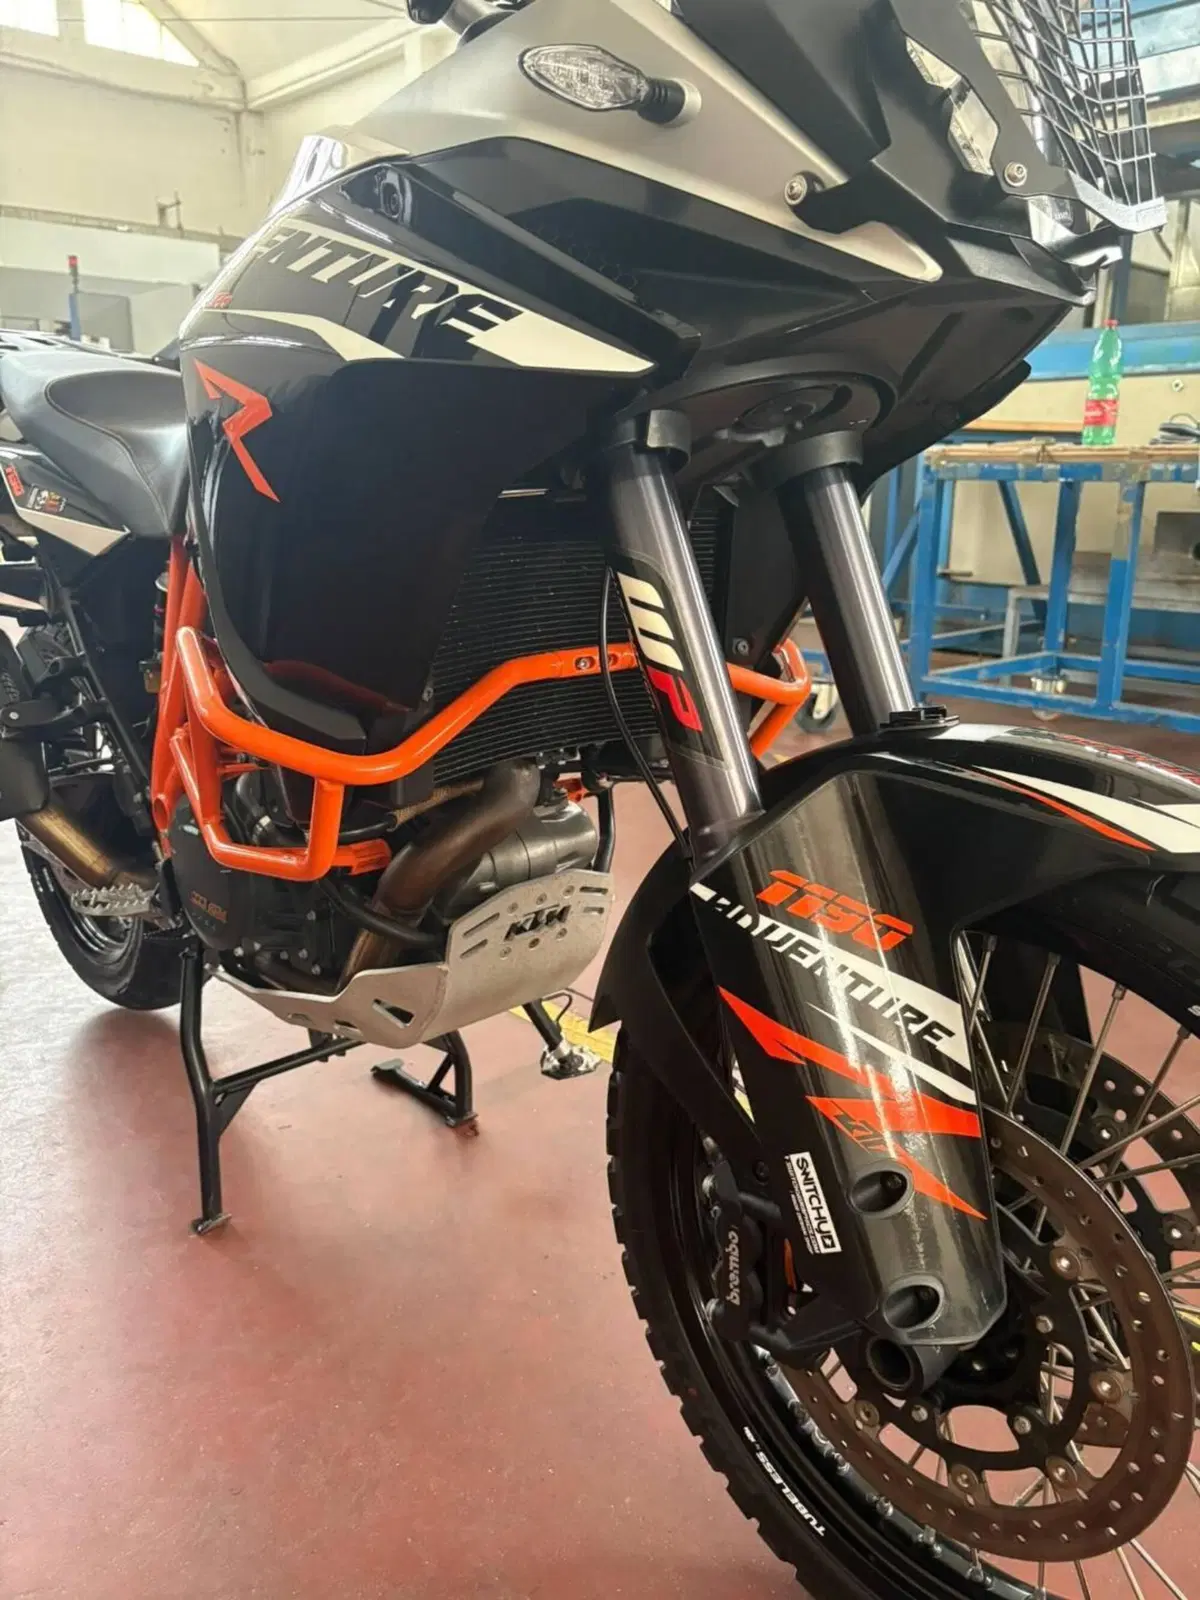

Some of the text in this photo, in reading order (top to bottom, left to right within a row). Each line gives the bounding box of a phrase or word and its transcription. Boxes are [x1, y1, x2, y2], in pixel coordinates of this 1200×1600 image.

[504, 904, 571, 941] KTM
[725, 1230, 741, 1306] brembo
[756, 1451, 826, 1536] TUBELESS
